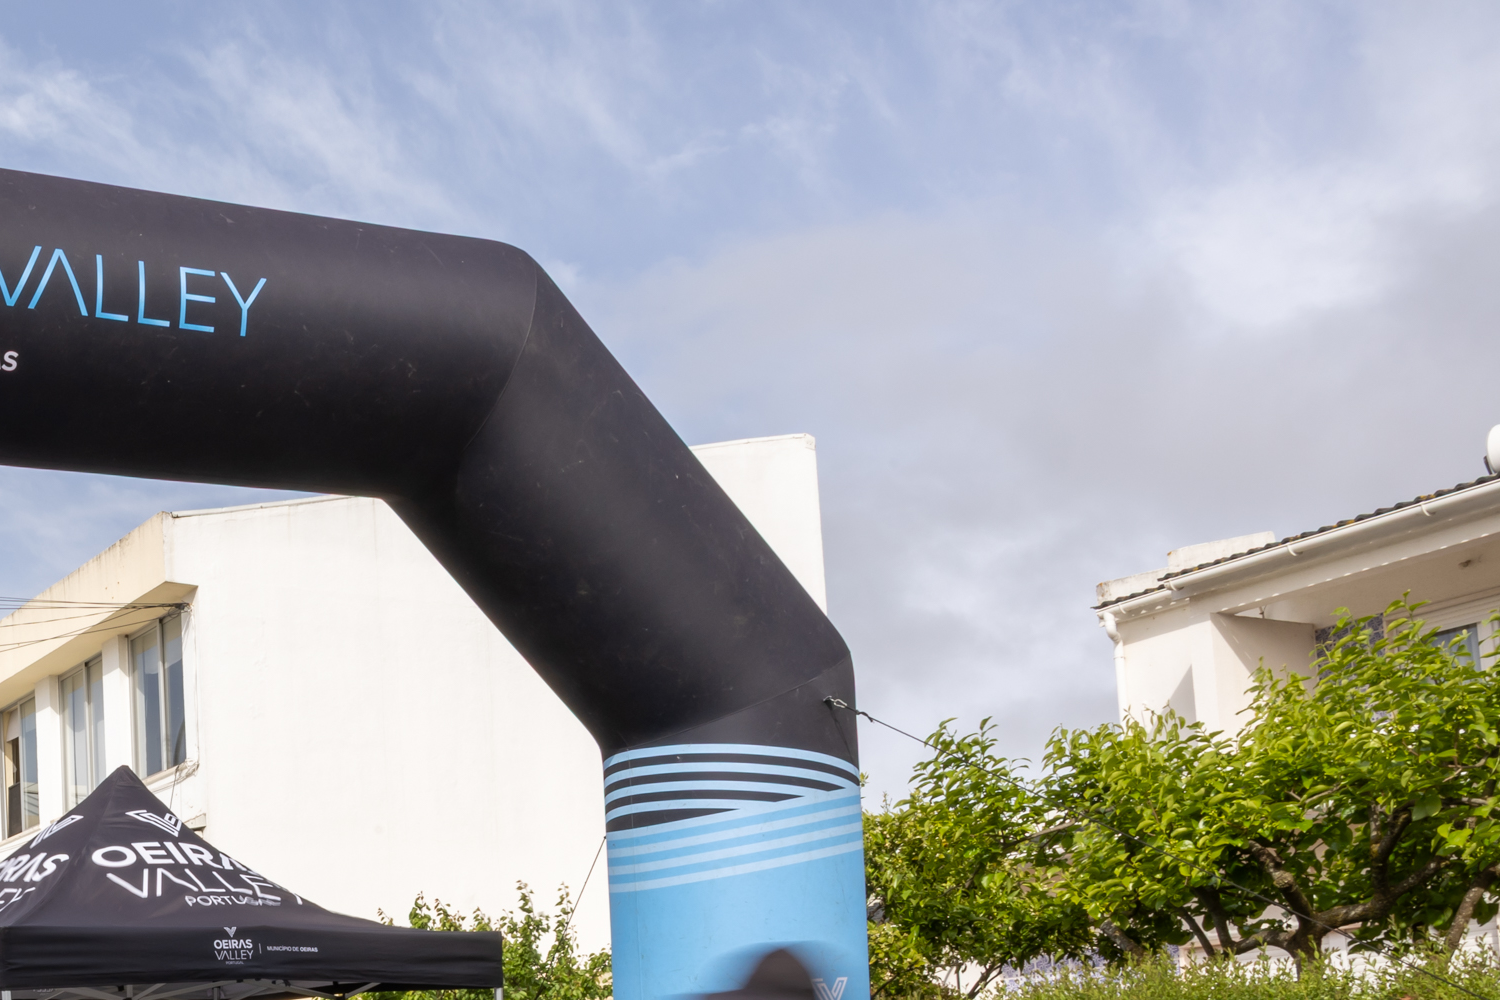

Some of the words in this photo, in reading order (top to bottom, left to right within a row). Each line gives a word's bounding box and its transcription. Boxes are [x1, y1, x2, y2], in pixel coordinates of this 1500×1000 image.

[91, 841, 262, 877] OEIRA
[213, 939, 253, 949] OEIRAS
[214, 950, 253, 960] VALLEY
